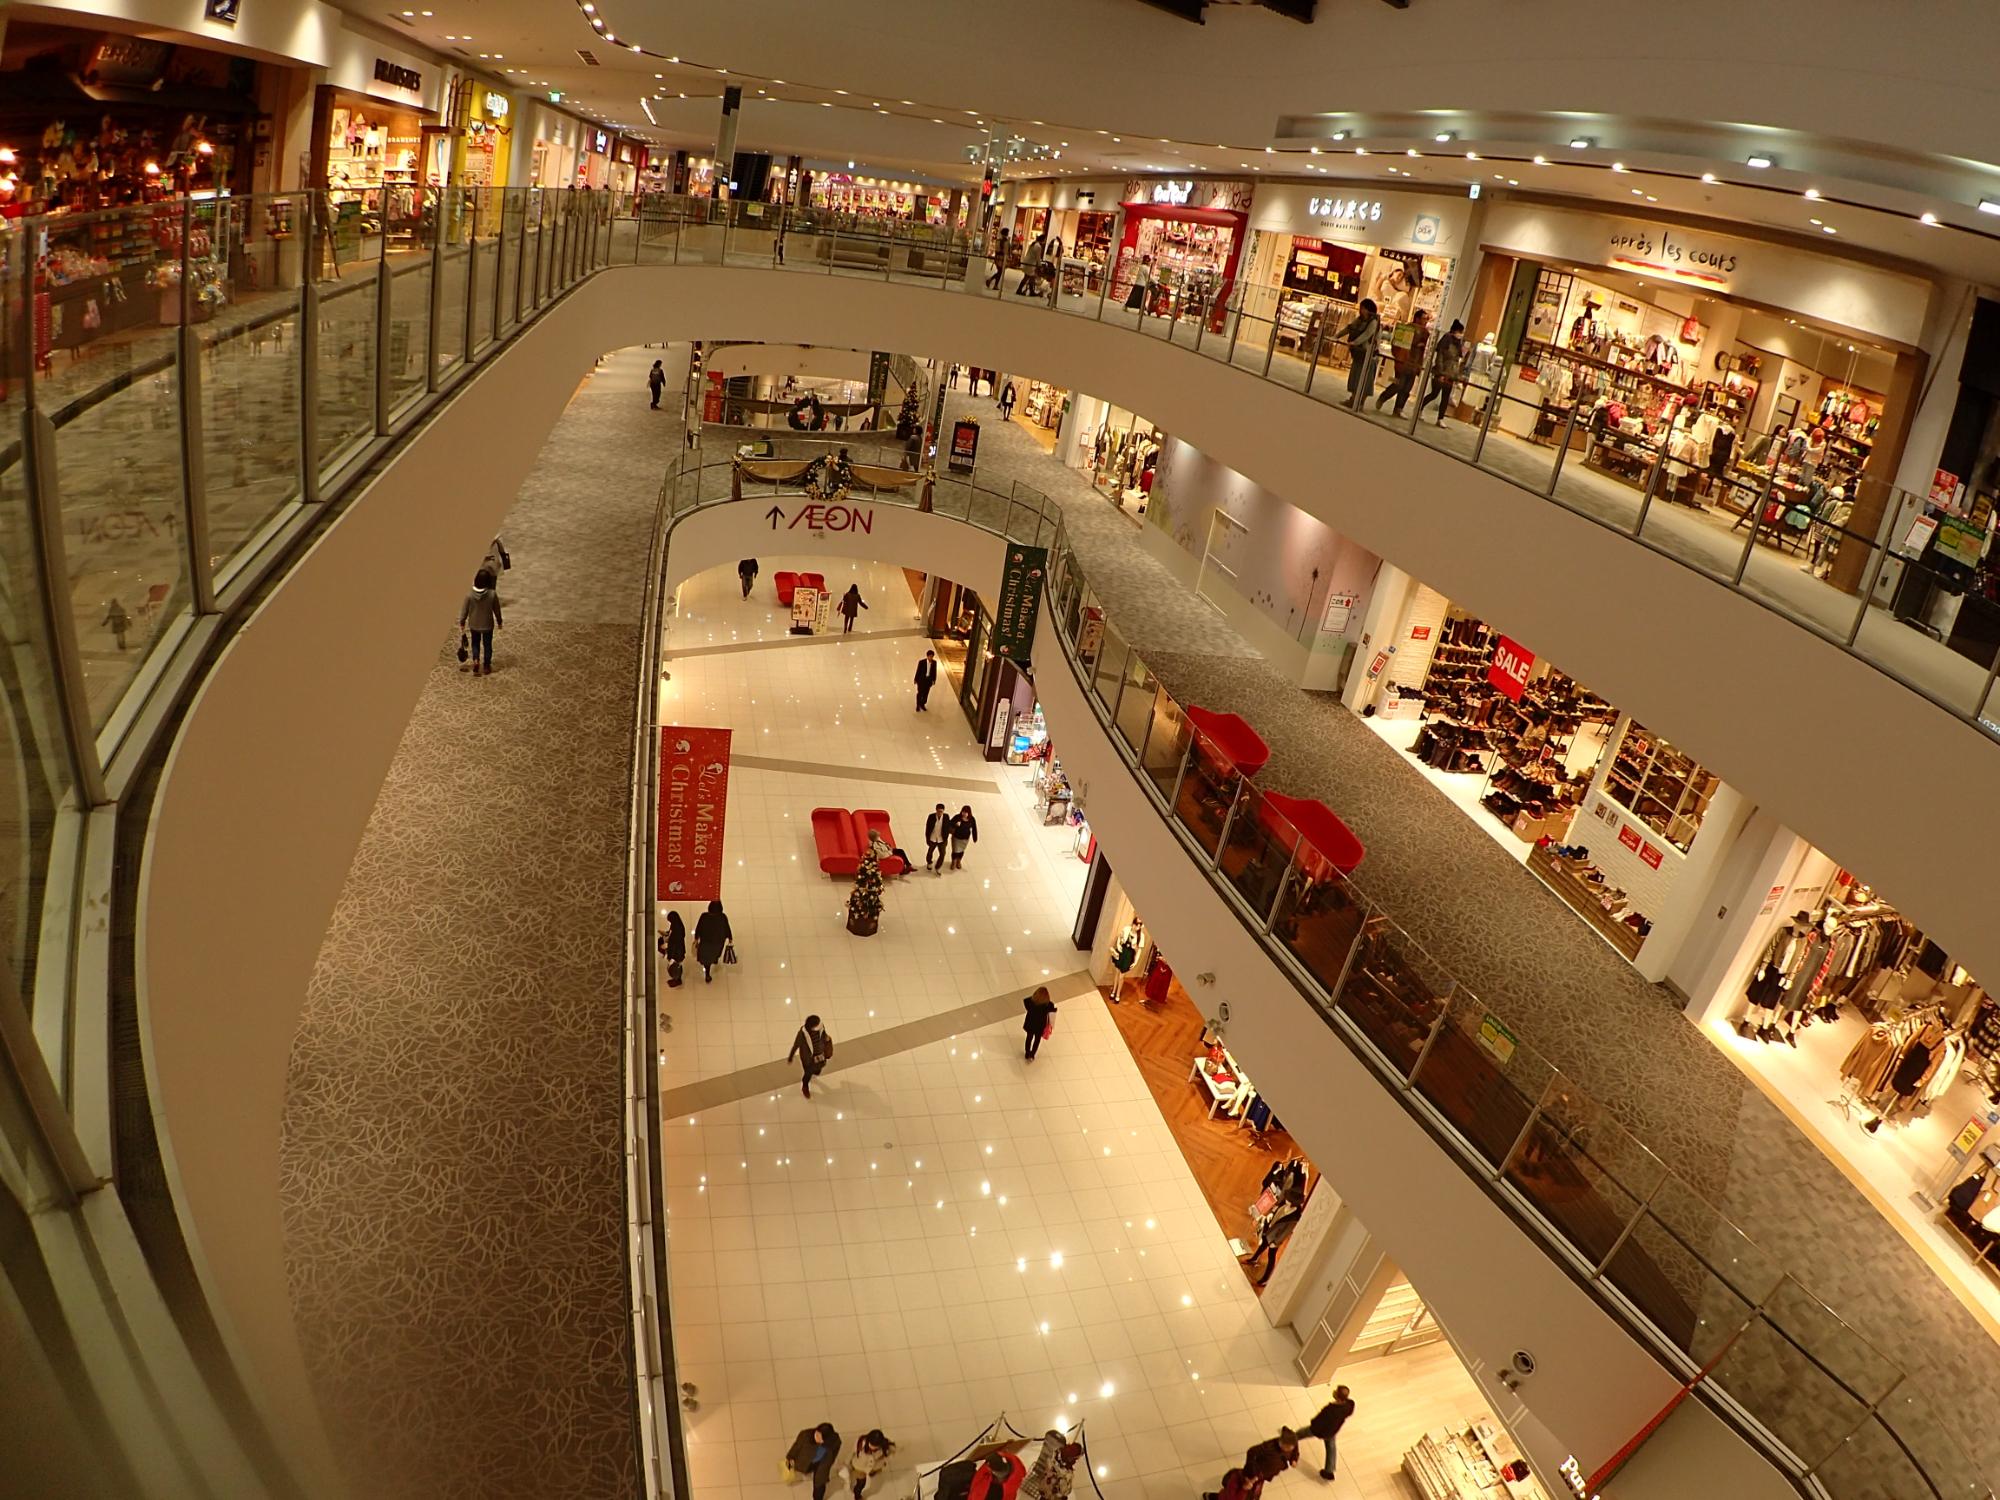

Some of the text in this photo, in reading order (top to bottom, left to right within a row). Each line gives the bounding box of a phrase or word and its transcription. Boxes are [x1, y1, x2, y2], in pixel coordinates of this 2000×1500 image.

[1308, 197, 1382, 220] じぶんまくら
[1610, 230, 1738, 273] après les cours
[1495, 646, 1530, 685] SALE
[667, 764, 690, 869] Christmas!
[694, 803, 714, 855] Make
